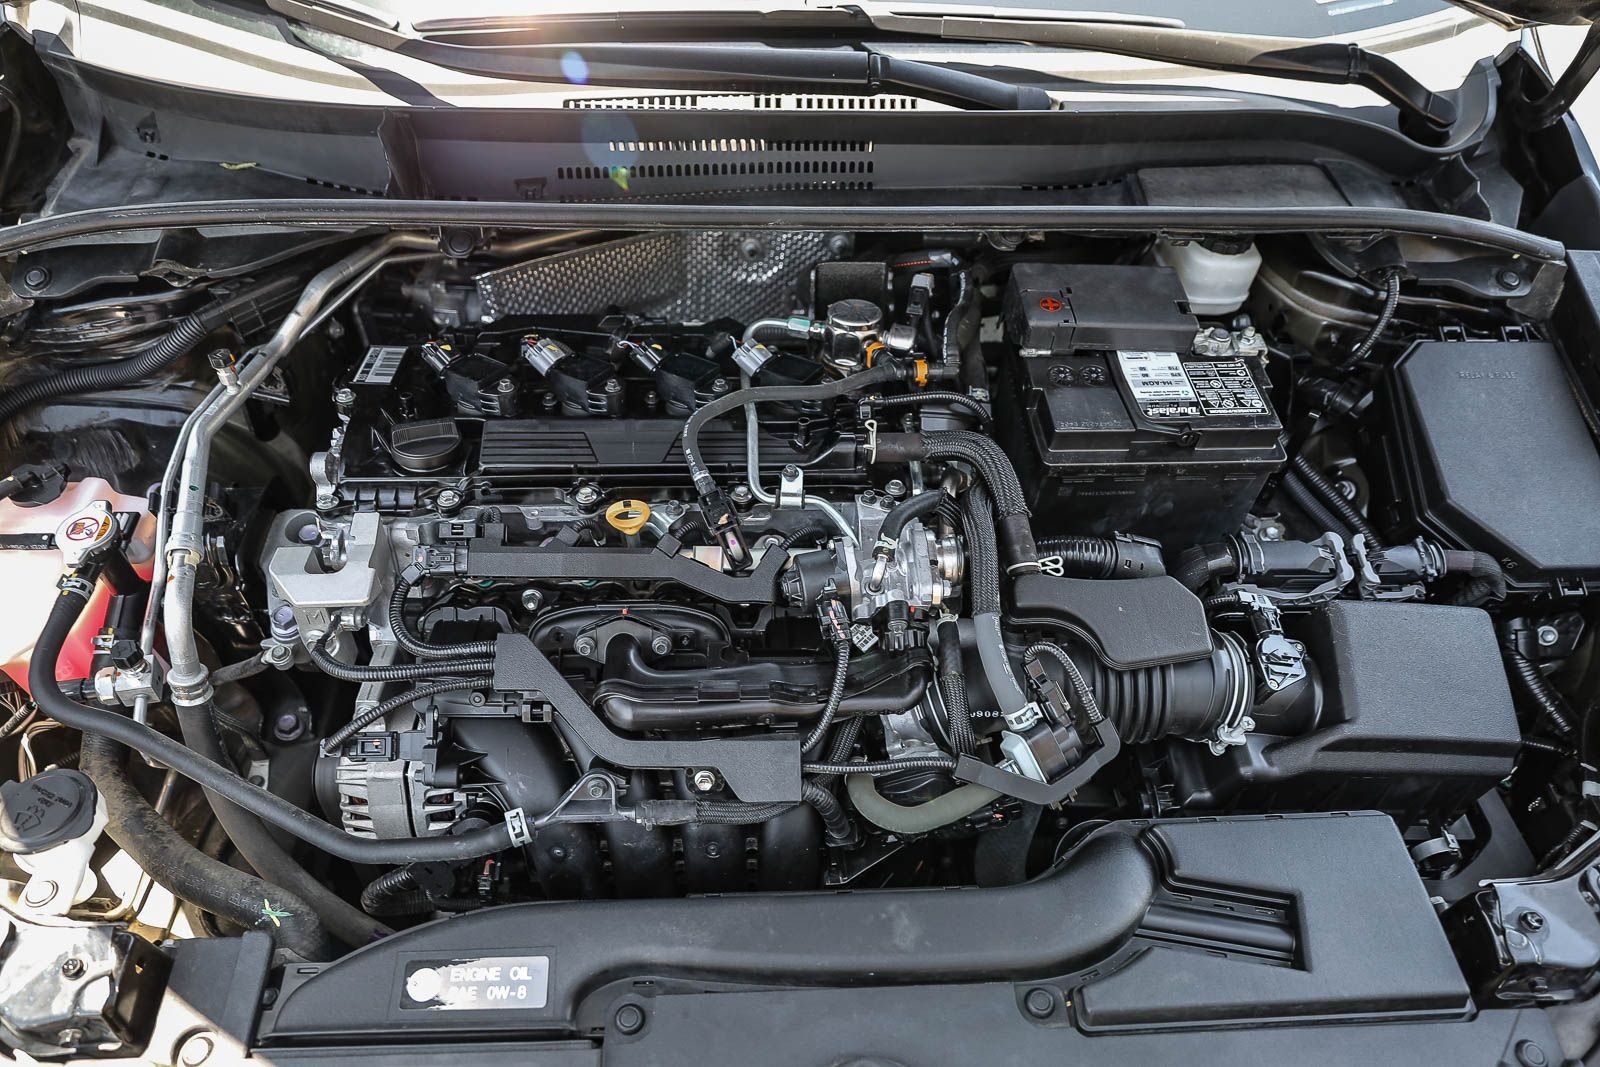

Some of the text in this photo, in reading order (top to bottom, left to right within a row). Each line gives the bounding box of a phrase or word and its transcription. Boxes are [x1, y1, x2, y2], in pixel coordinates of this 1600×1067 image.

[1147, 406, 1200, 416] Duralast
[450, 966, 532, 981] ENGINE OIL
[487, 985, 527, 1000] 0W-8
